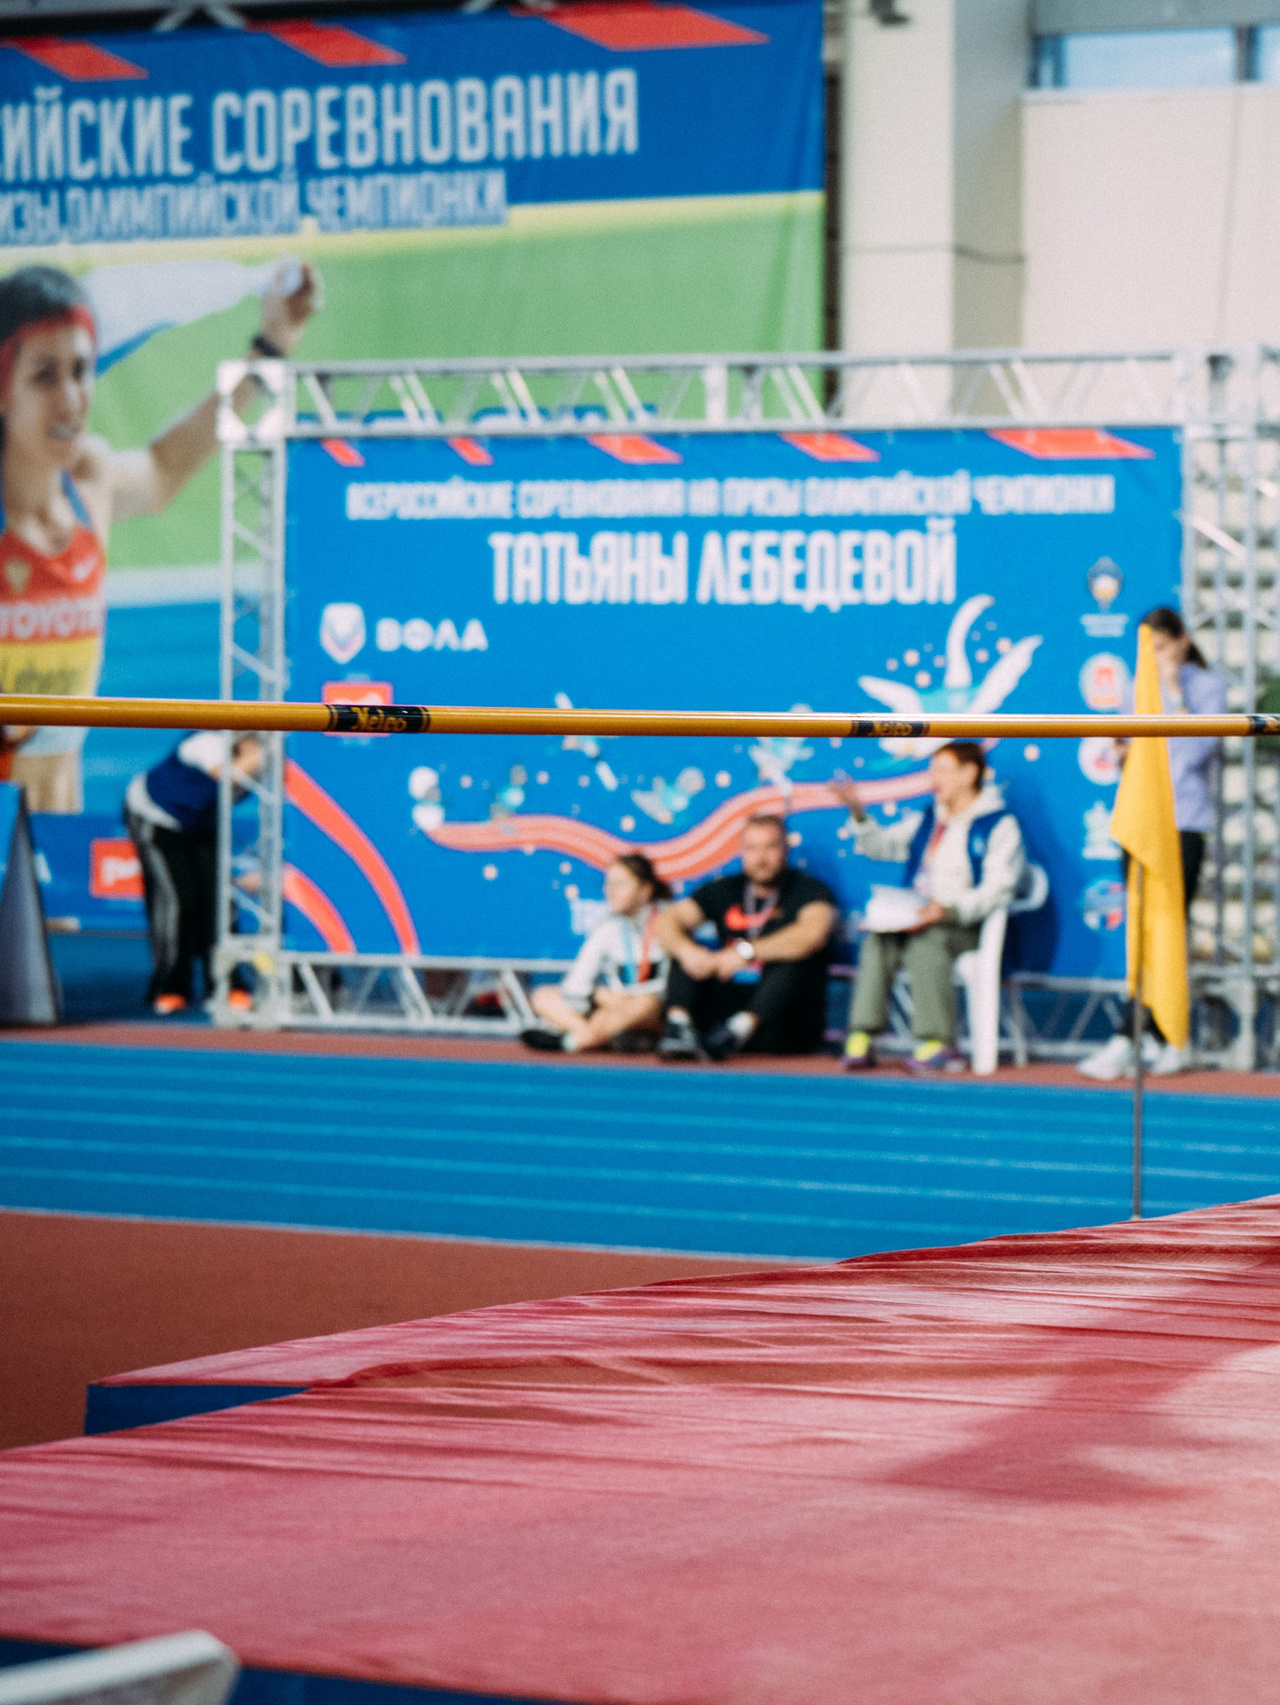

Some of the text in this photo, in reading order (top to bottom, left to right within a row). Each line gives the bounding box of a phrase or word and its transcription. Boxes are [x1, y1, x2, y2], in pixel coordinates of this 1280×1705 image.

[2, 67, 639, 182] ИЙСКИЕ СОРЕВНОВАНИЯ
[488, 516, 957, 613] ТАТЬЯНЫ ЛЕБЕДЕВОЙ
[350, 706, 408, 731] Nelco
